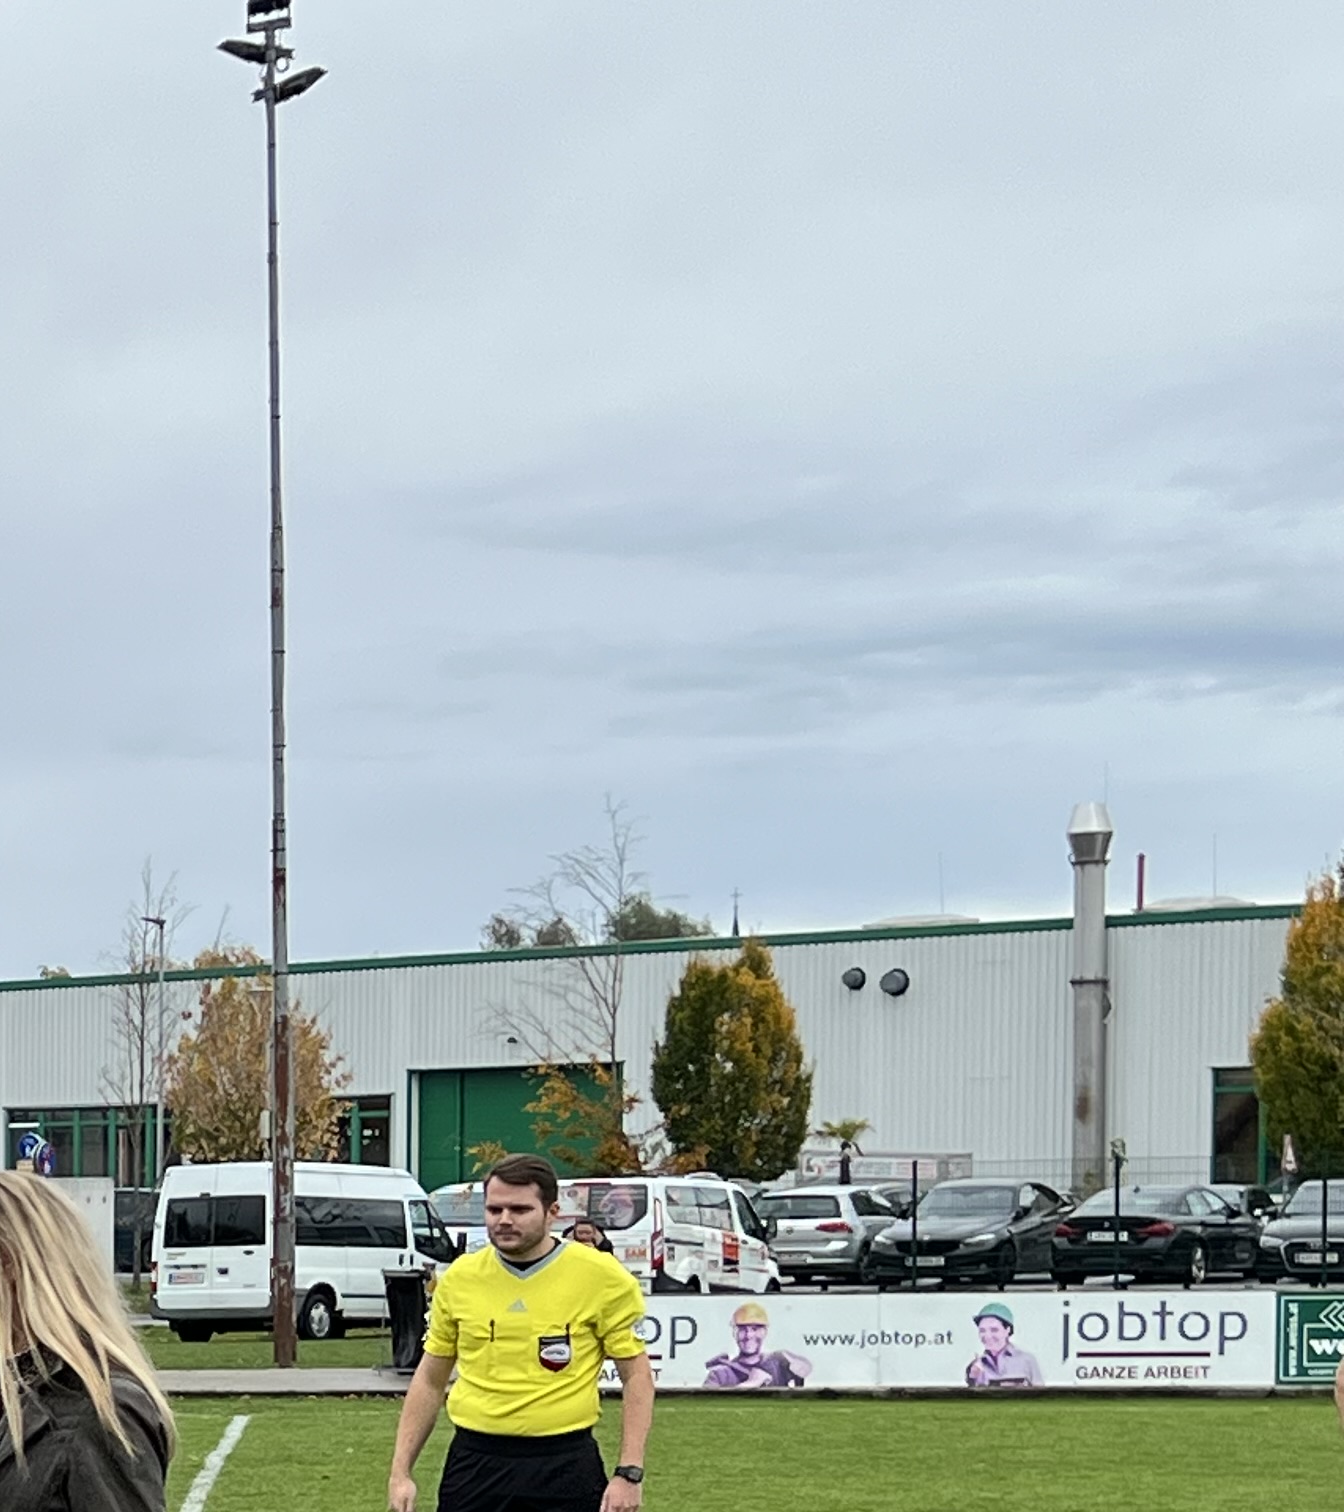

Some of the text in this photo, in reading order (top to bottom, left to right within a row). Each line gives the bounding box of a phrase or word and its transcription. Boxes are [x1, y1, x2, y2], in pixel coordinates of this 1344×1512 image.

[803, 1329, 954, 1349] www.jobtop.at
[1061, 1301, 1249, 1363] jobtop
[1075, 1365, 1211, 1380] GANZE ARBEIT
